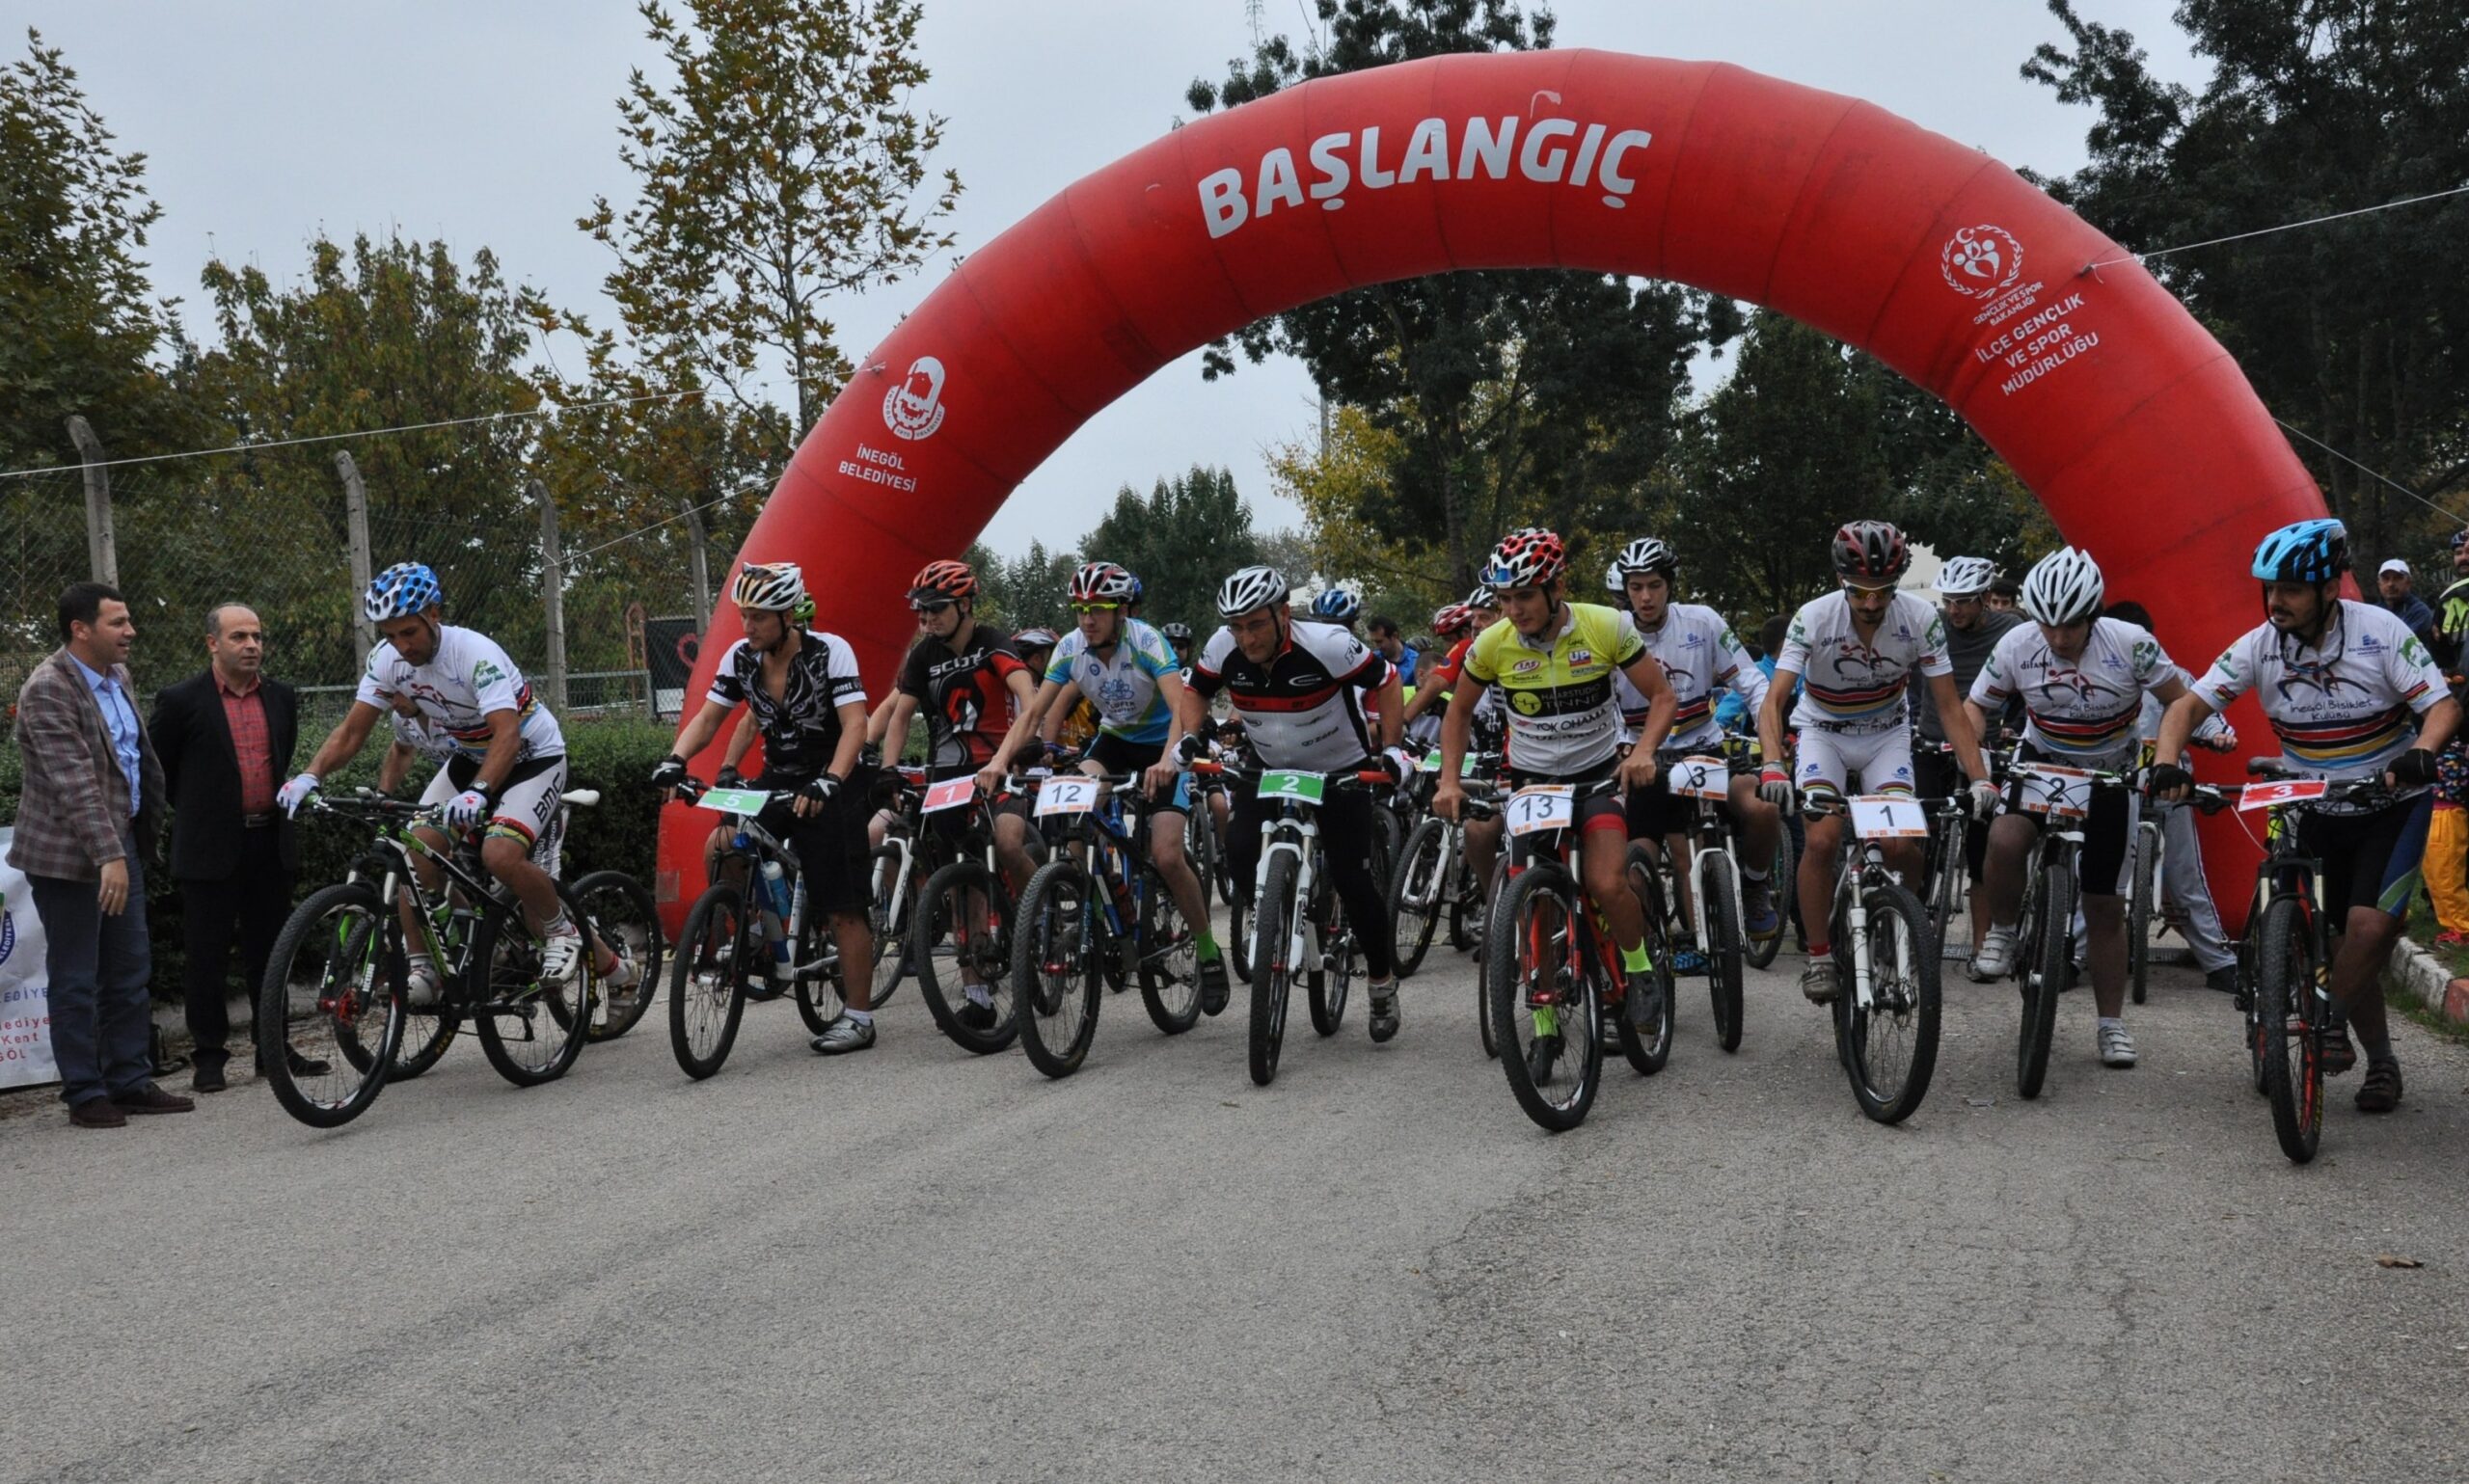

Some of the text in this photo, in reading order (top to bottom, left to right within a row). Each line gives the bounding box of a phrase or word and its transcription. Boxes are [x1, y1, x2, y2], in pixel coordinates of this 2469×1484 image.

[1198, 116, 1651, 238] BAŞLANGIÇ
[1974, 334, 2013, 363] İLÇE
[2005, 323, 2073, 368] VE SPOR
[856, 443, 905, 471] İNEGÖL
[838, 461, 916, 493] BELEDİYESİ
[1569, 650, 1590, 661] UP
[1280, 774, 1300, 793] 2
[1693, 766, 1706, 788] 3
[532, 771, 564, 823] BMC
[723, 794, 743, 807] 5
[945, 786, 956, 803] 1
[1052, 785, 1081, 803] 12
[2046, 777, 2066, 803] 2
[2270, 785, 2293, 798] 3
[1520, 796, 1554, 822] 13
[1879, 805, 1894, 827] 1
[0, 986, 49, 1005] EDİYE
[0, 1016, 51, 1031] ediye
[2, 1032, 40, 1045] Kent
